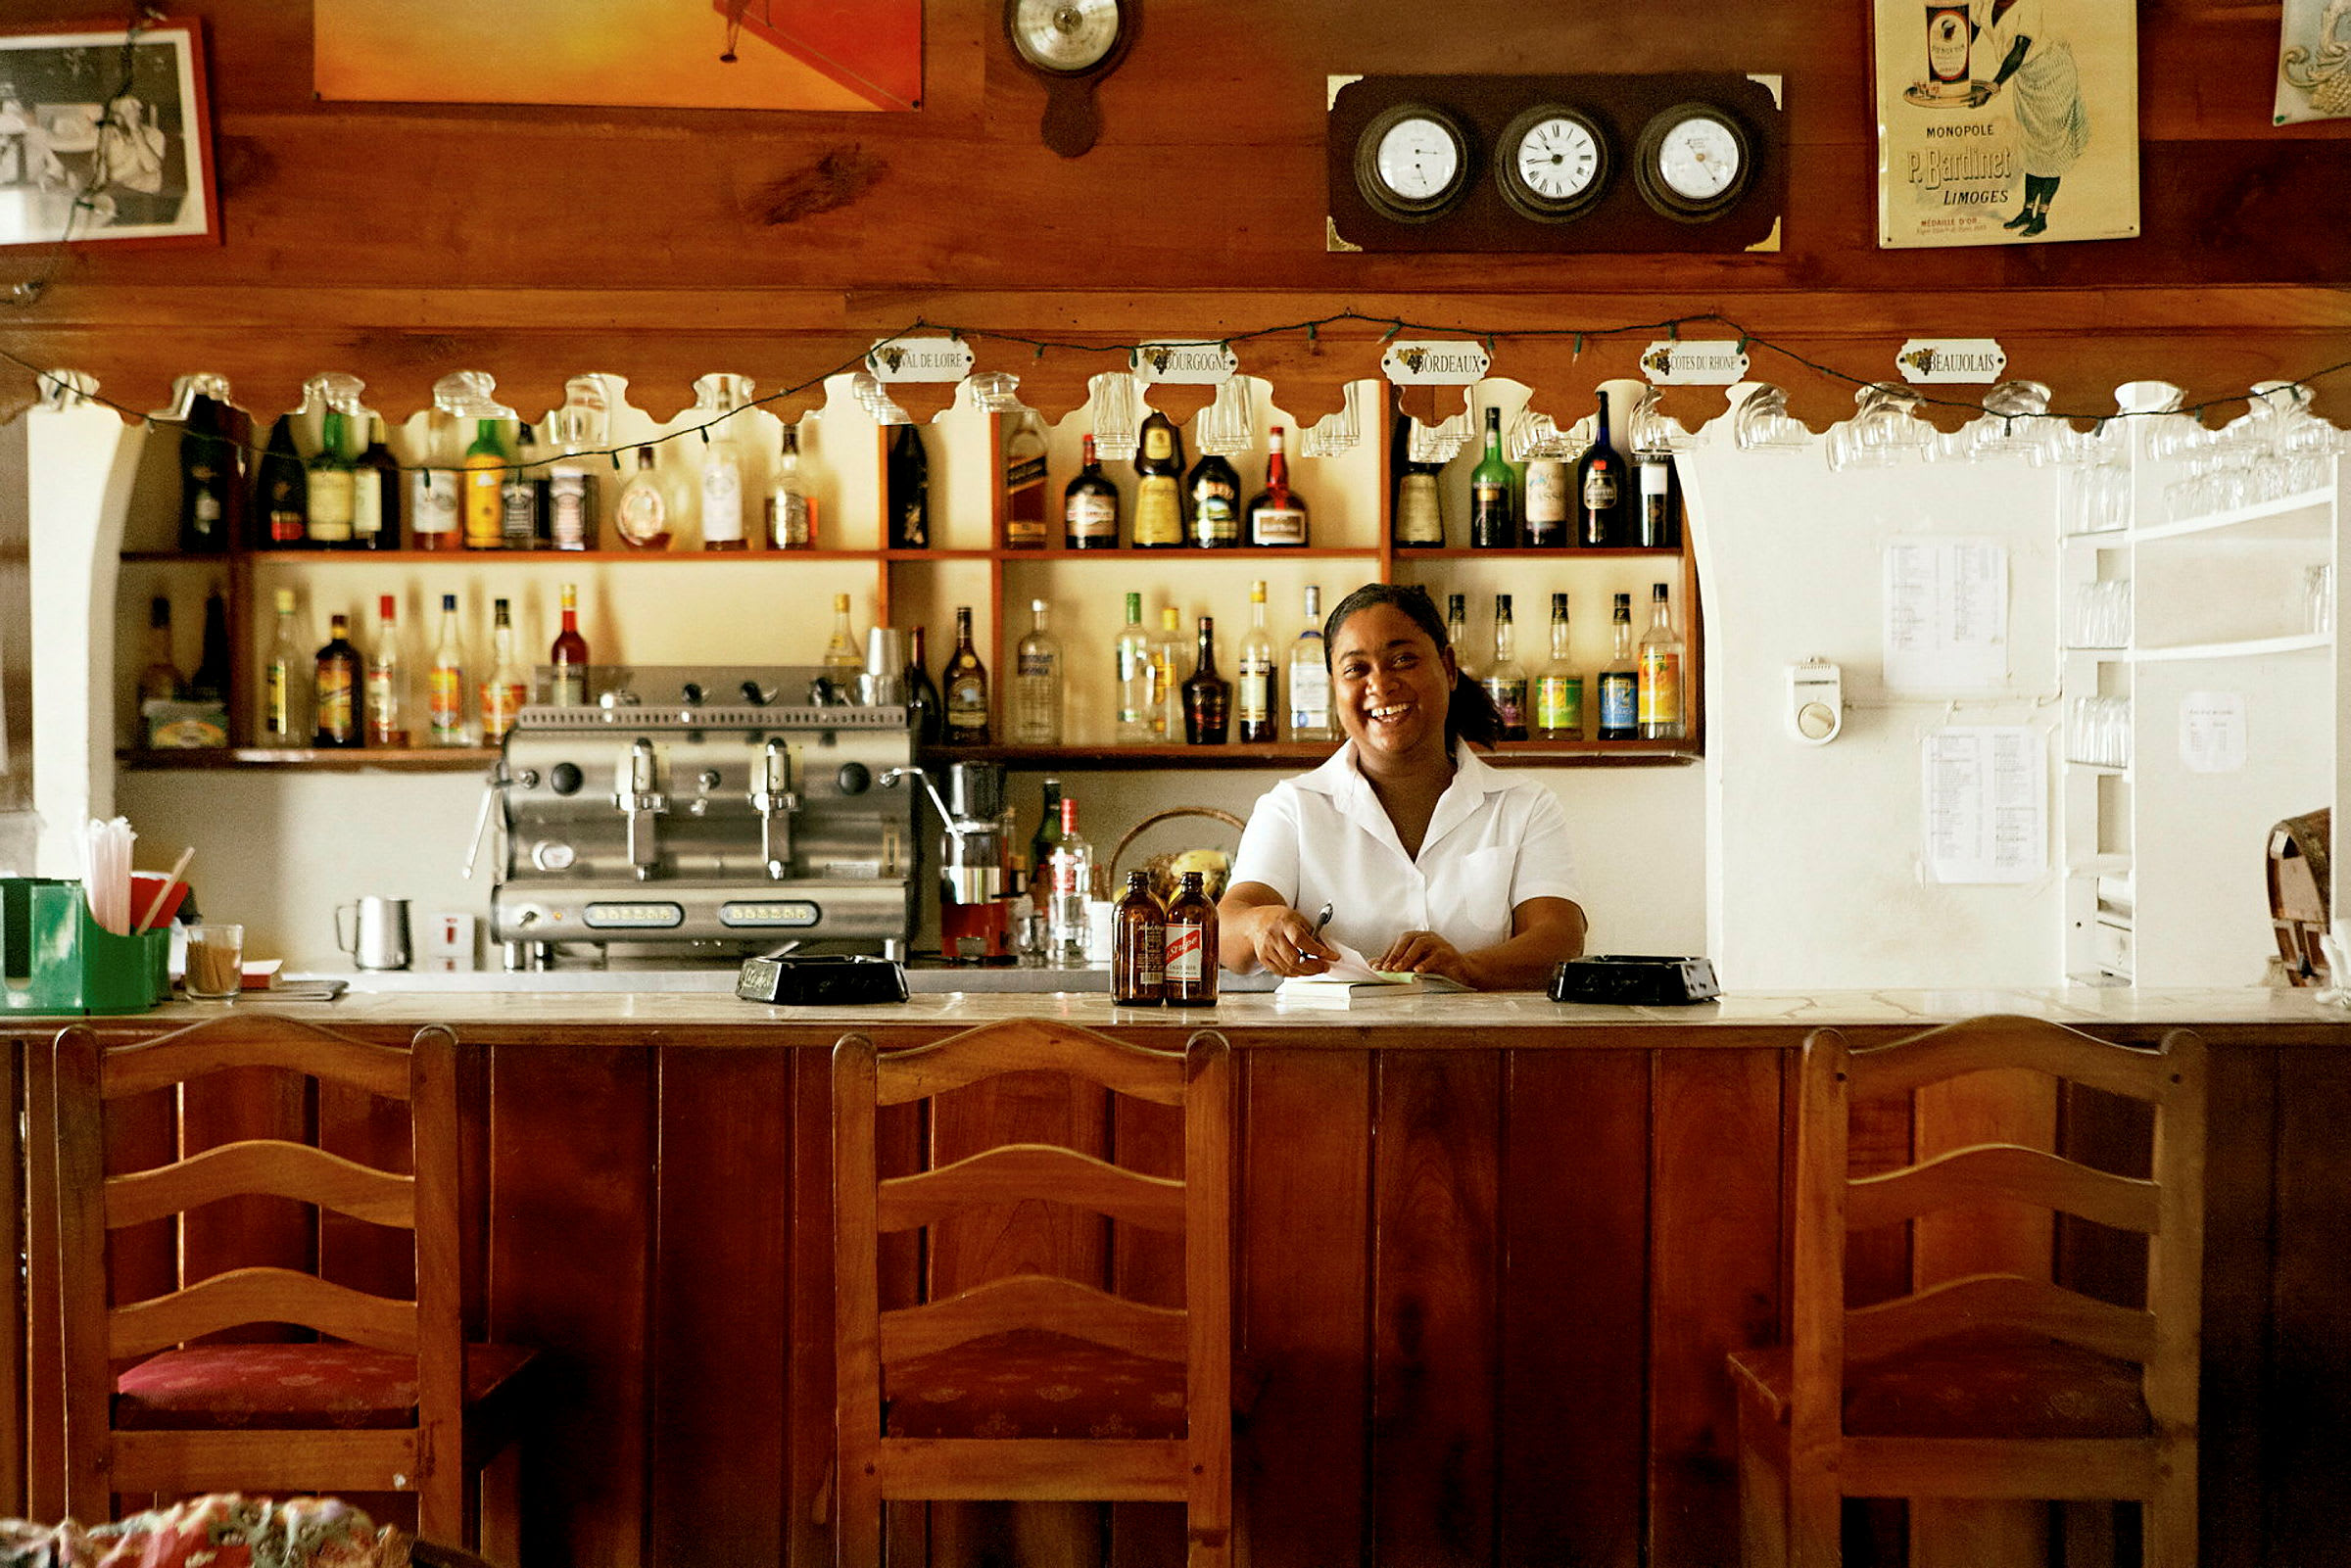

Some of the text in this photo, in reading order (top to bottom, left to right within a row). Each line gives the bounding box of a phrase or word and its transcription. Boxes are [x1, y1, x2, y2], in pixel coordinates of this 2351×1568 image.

[1926, 124, 1994, 138] MONOPOLE
[1926, 146, 2012, 191] Bardinet
[1943, 190, 2009, 206] LIMOGES
[920, 354, 934, 368] DE
[934, 353, 963, 368] LOIRE
[1167, 354, 1229, 371] BOURGOGNE
[1419, 355, 1481, 372] BORDEAUX
[1696, 356, 1708, 370] DU
[1930, 354, 1995, 372] BEAUJOLAIS
